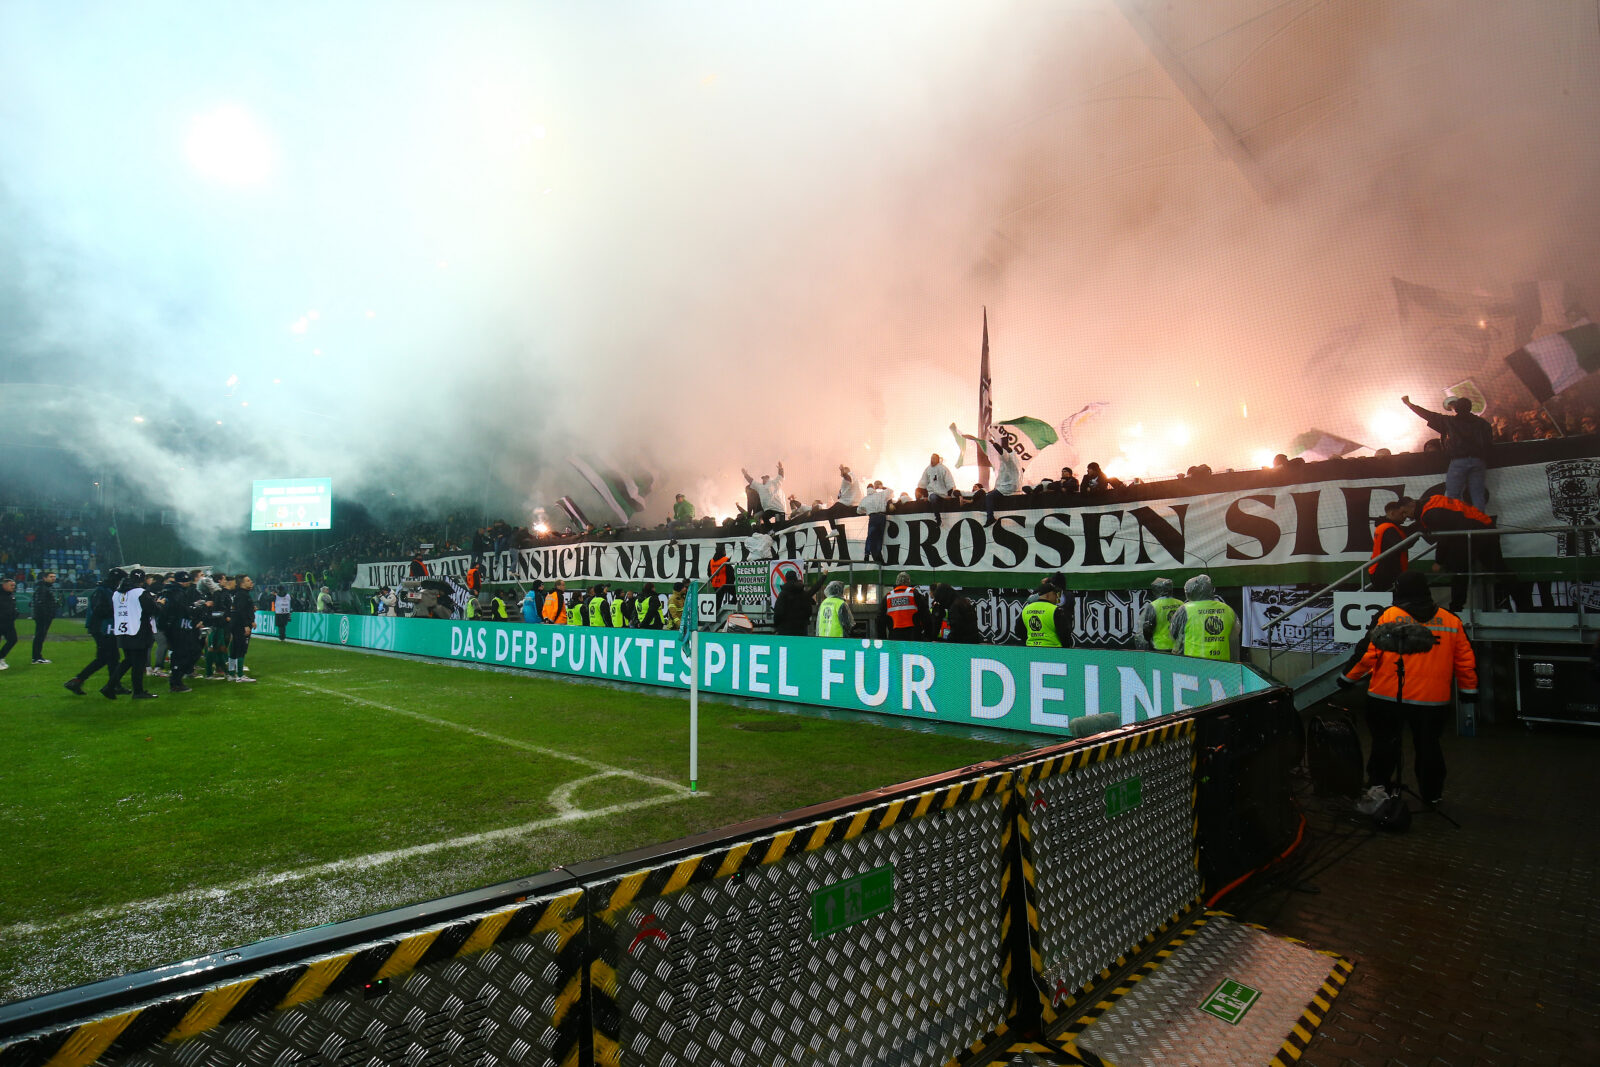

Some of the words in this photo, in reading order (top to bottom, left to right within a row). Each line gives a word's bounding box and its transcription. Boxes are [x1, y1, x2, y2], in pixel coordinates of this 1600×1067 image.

[614, 544, 701, 579] NACH
[700, 600, 715, 616] C2
[451, 626, 487, 660] DAS
[495, 628, 800, 698] DFB-PUNKTESPIEL
[821, 638, 938, 714] FÜR
